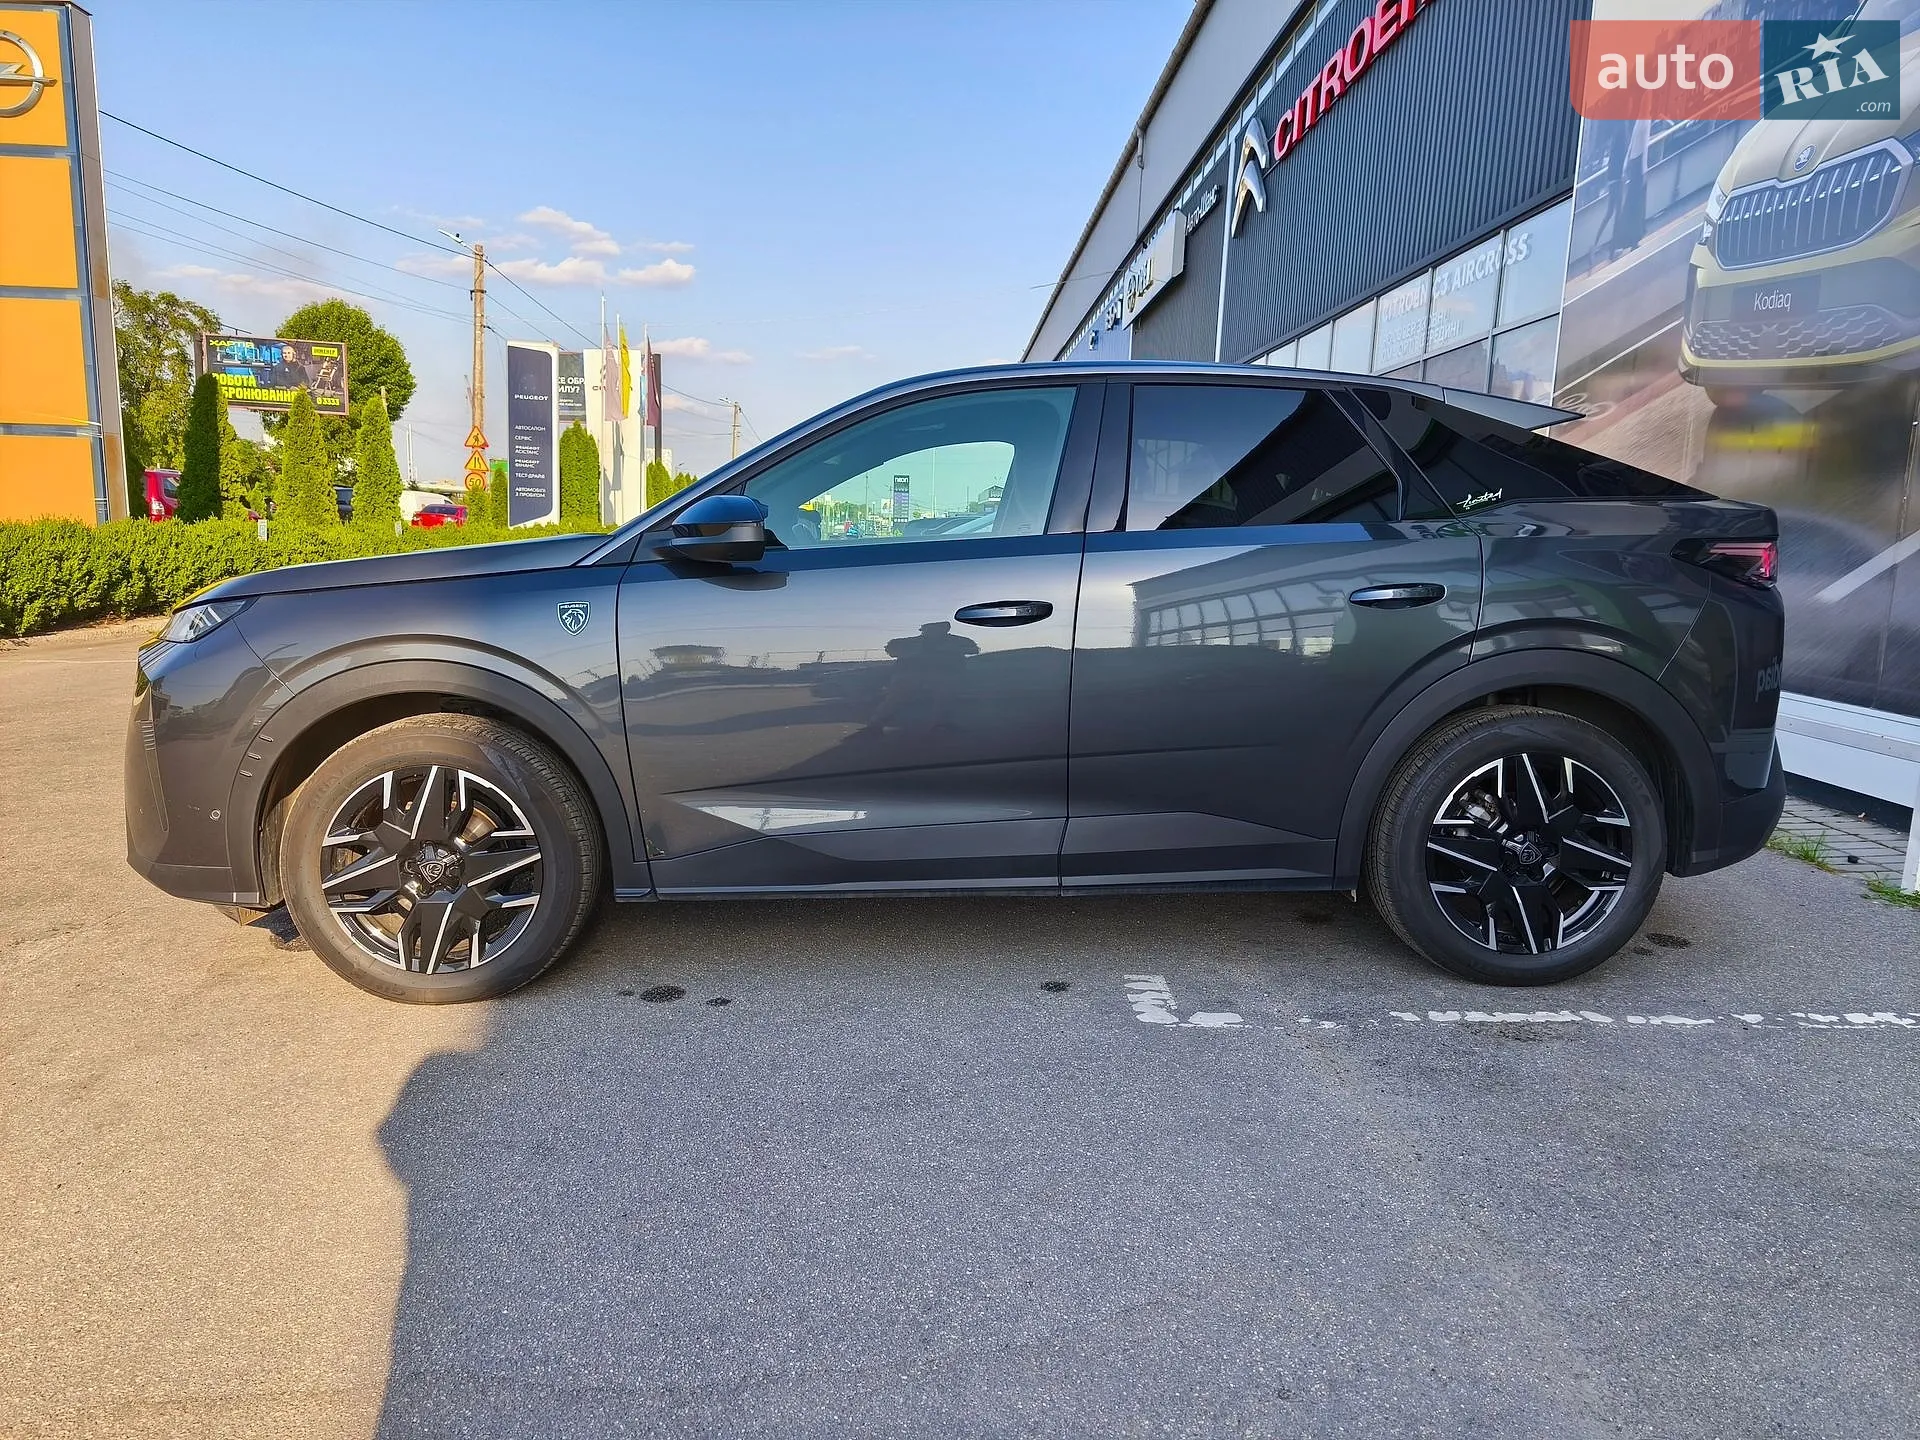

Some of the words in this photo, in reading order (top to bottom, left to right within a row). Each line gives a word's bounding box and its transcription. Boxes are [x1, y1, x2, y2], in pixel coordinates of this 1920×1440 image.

[1274, 0, 1424, 160] CITROE
[1451, 232, 1529, 293] AIRCROSS
[1753, 289, 1791, 312] Kodiaq
[567, 377, 585, 385] ОБР
[469, 477, 481, 487] 50
